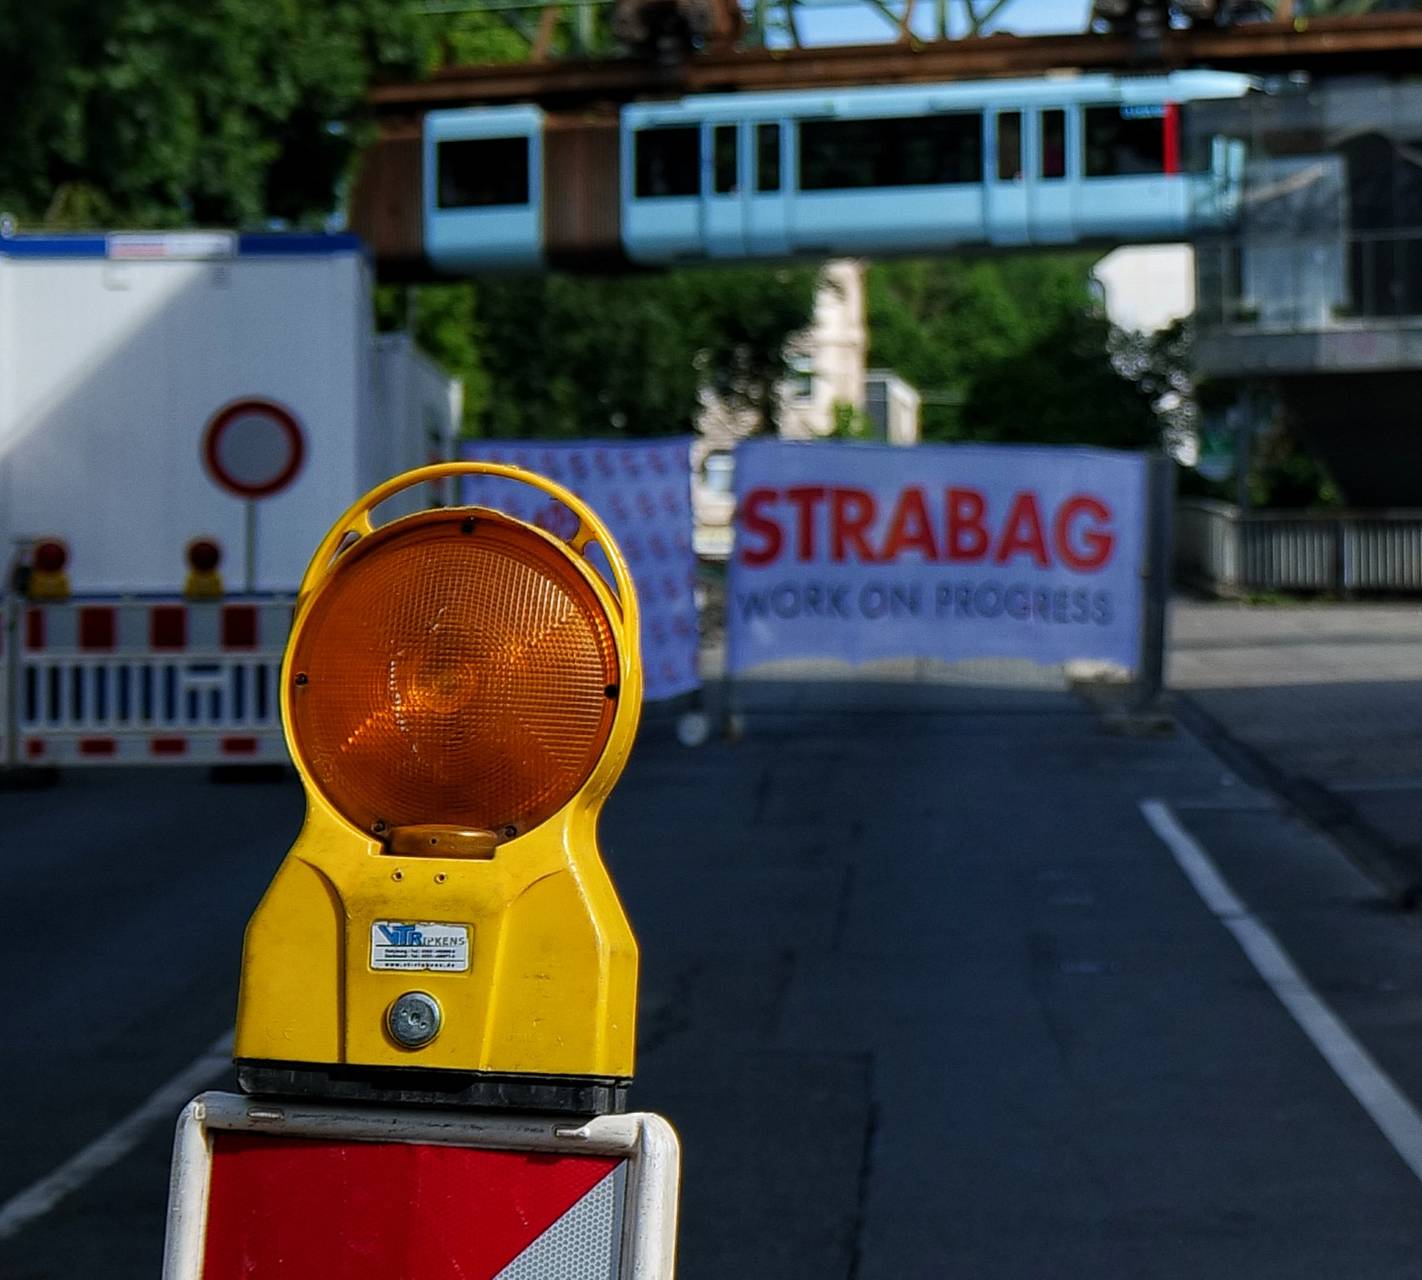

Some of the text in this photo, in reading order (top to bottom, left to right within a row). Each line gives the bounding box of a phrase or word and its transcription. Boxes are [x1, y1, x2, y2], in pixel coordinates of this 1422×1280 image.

[739, 484, 1118, 575] STRABAG
[738, 579, 1118, 626] WORK ON PROGRESS
